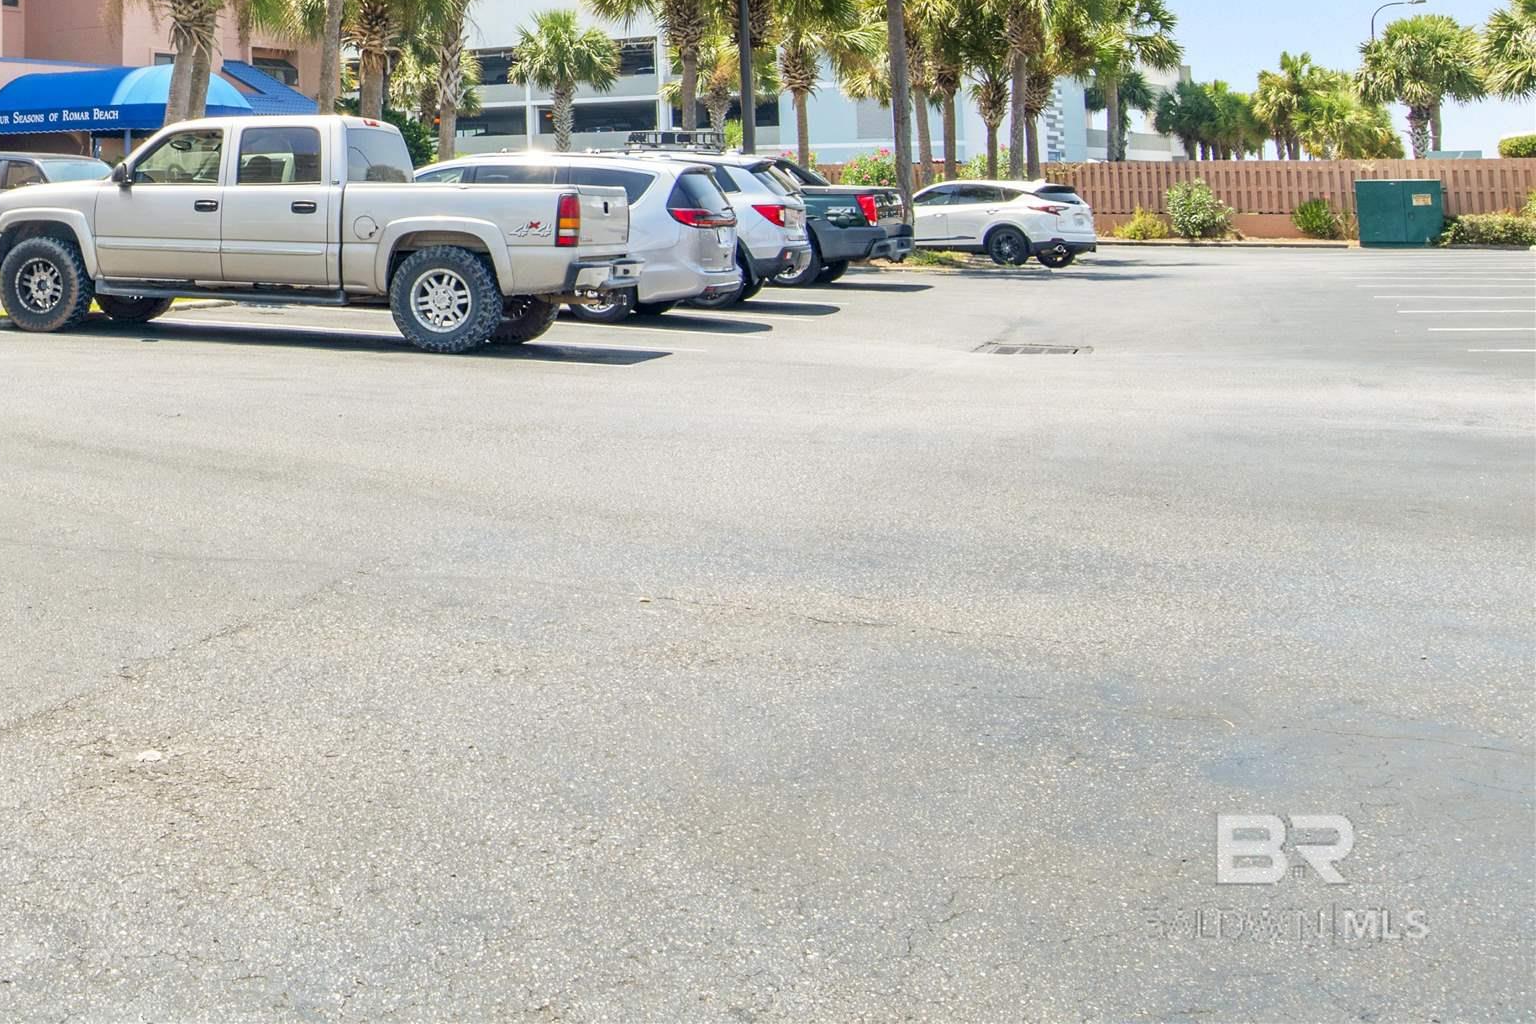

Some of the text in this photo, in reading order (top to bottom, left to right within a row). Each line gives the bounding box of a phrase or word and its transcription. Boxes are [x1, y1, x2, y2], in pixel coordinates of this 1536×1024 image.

[13, 111, 44, 124] SEASONS
[49, 112, 59, 122] OF
[62, 110, 90, 121] ROMAR
[93, 108, 119, 120] BEACH
